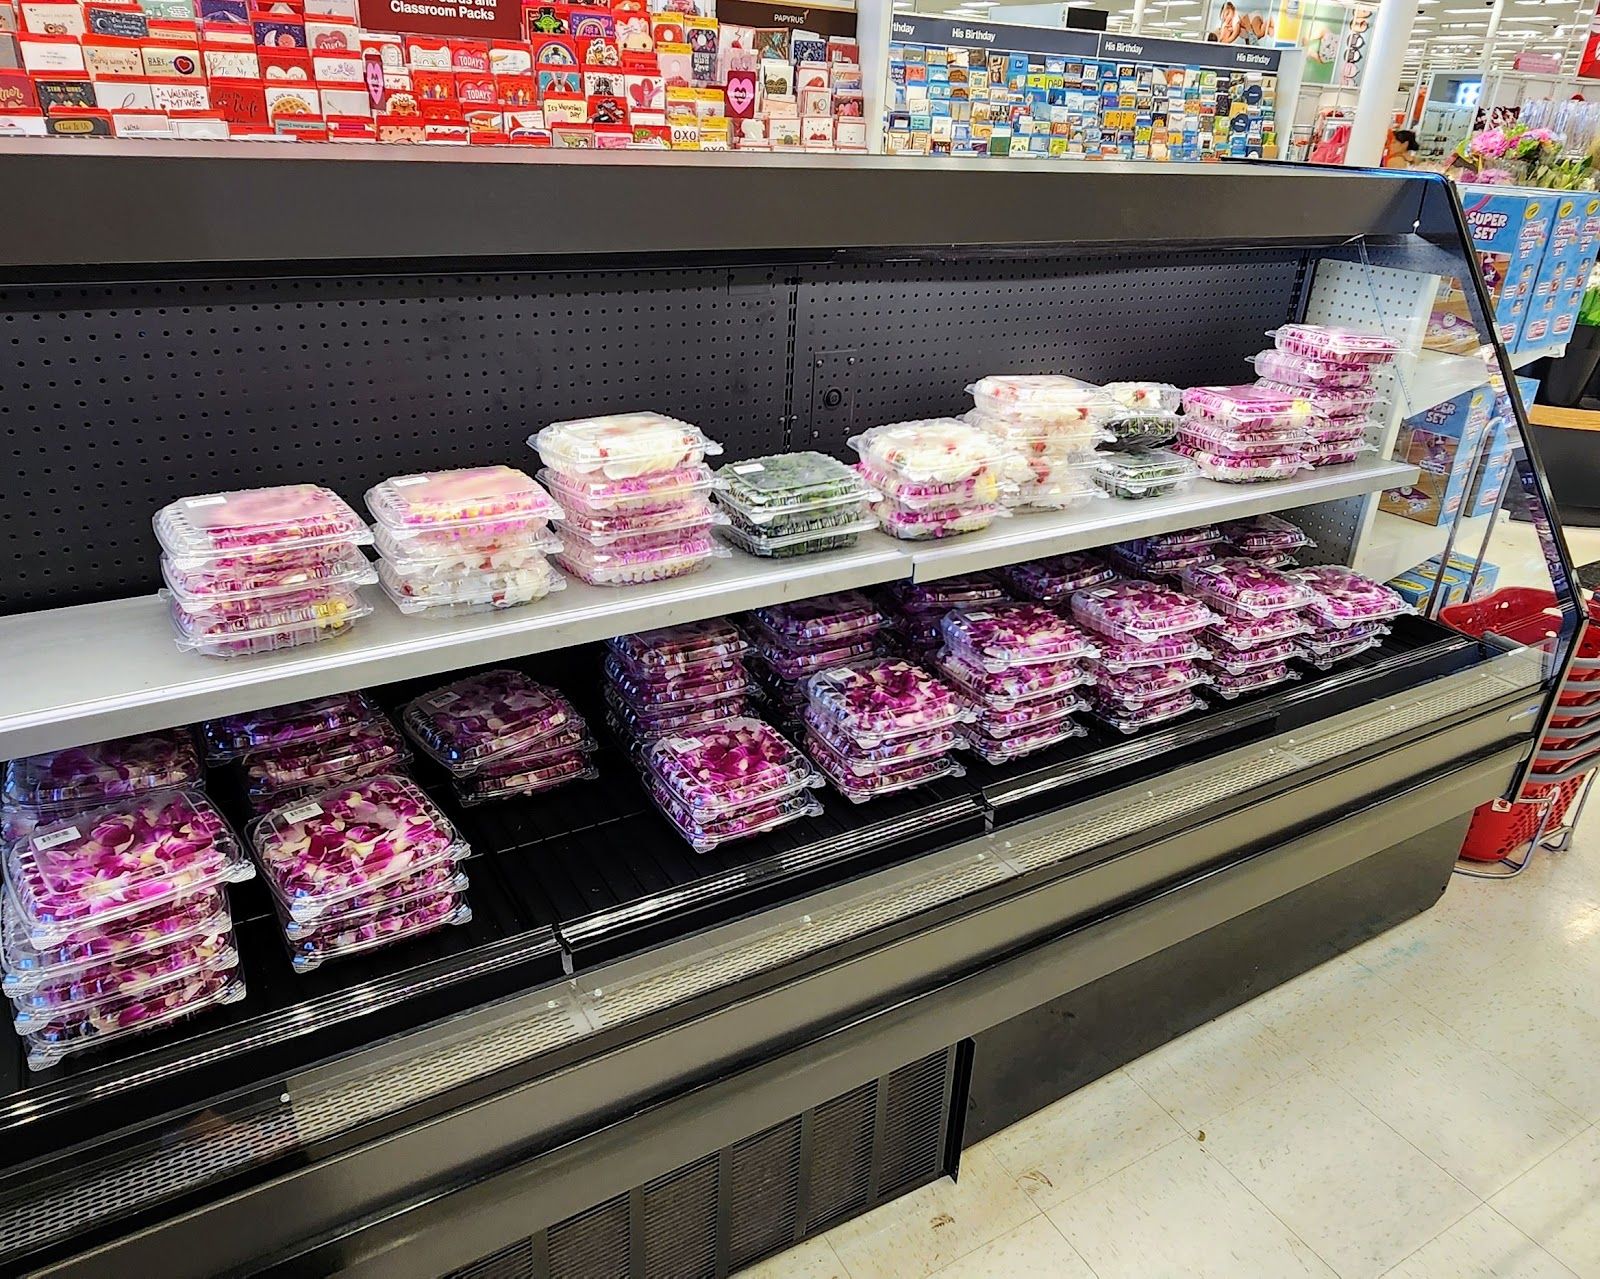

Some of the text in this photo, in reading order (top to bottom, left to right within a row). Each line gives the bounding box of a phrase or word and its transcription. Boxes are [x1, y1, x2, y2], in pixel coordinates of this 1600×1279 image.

[390, 1, 495, 21] Classroom Packs
[774, 14, 804, 24] PAPYRUS
[893, 22, 915, 36] thday
[952, 28, 996, 42] His Birthday
[1105, 41, 1143, 55] His Birthday
[1236, 53, 1271, 65] His Birthday
[1467, 212, 1508, 227] SUPER
[1473, 228, 1497, 240] SET
[1434, 402, 1456, 415] PER
[1425, 413, 1446, 425] SET
